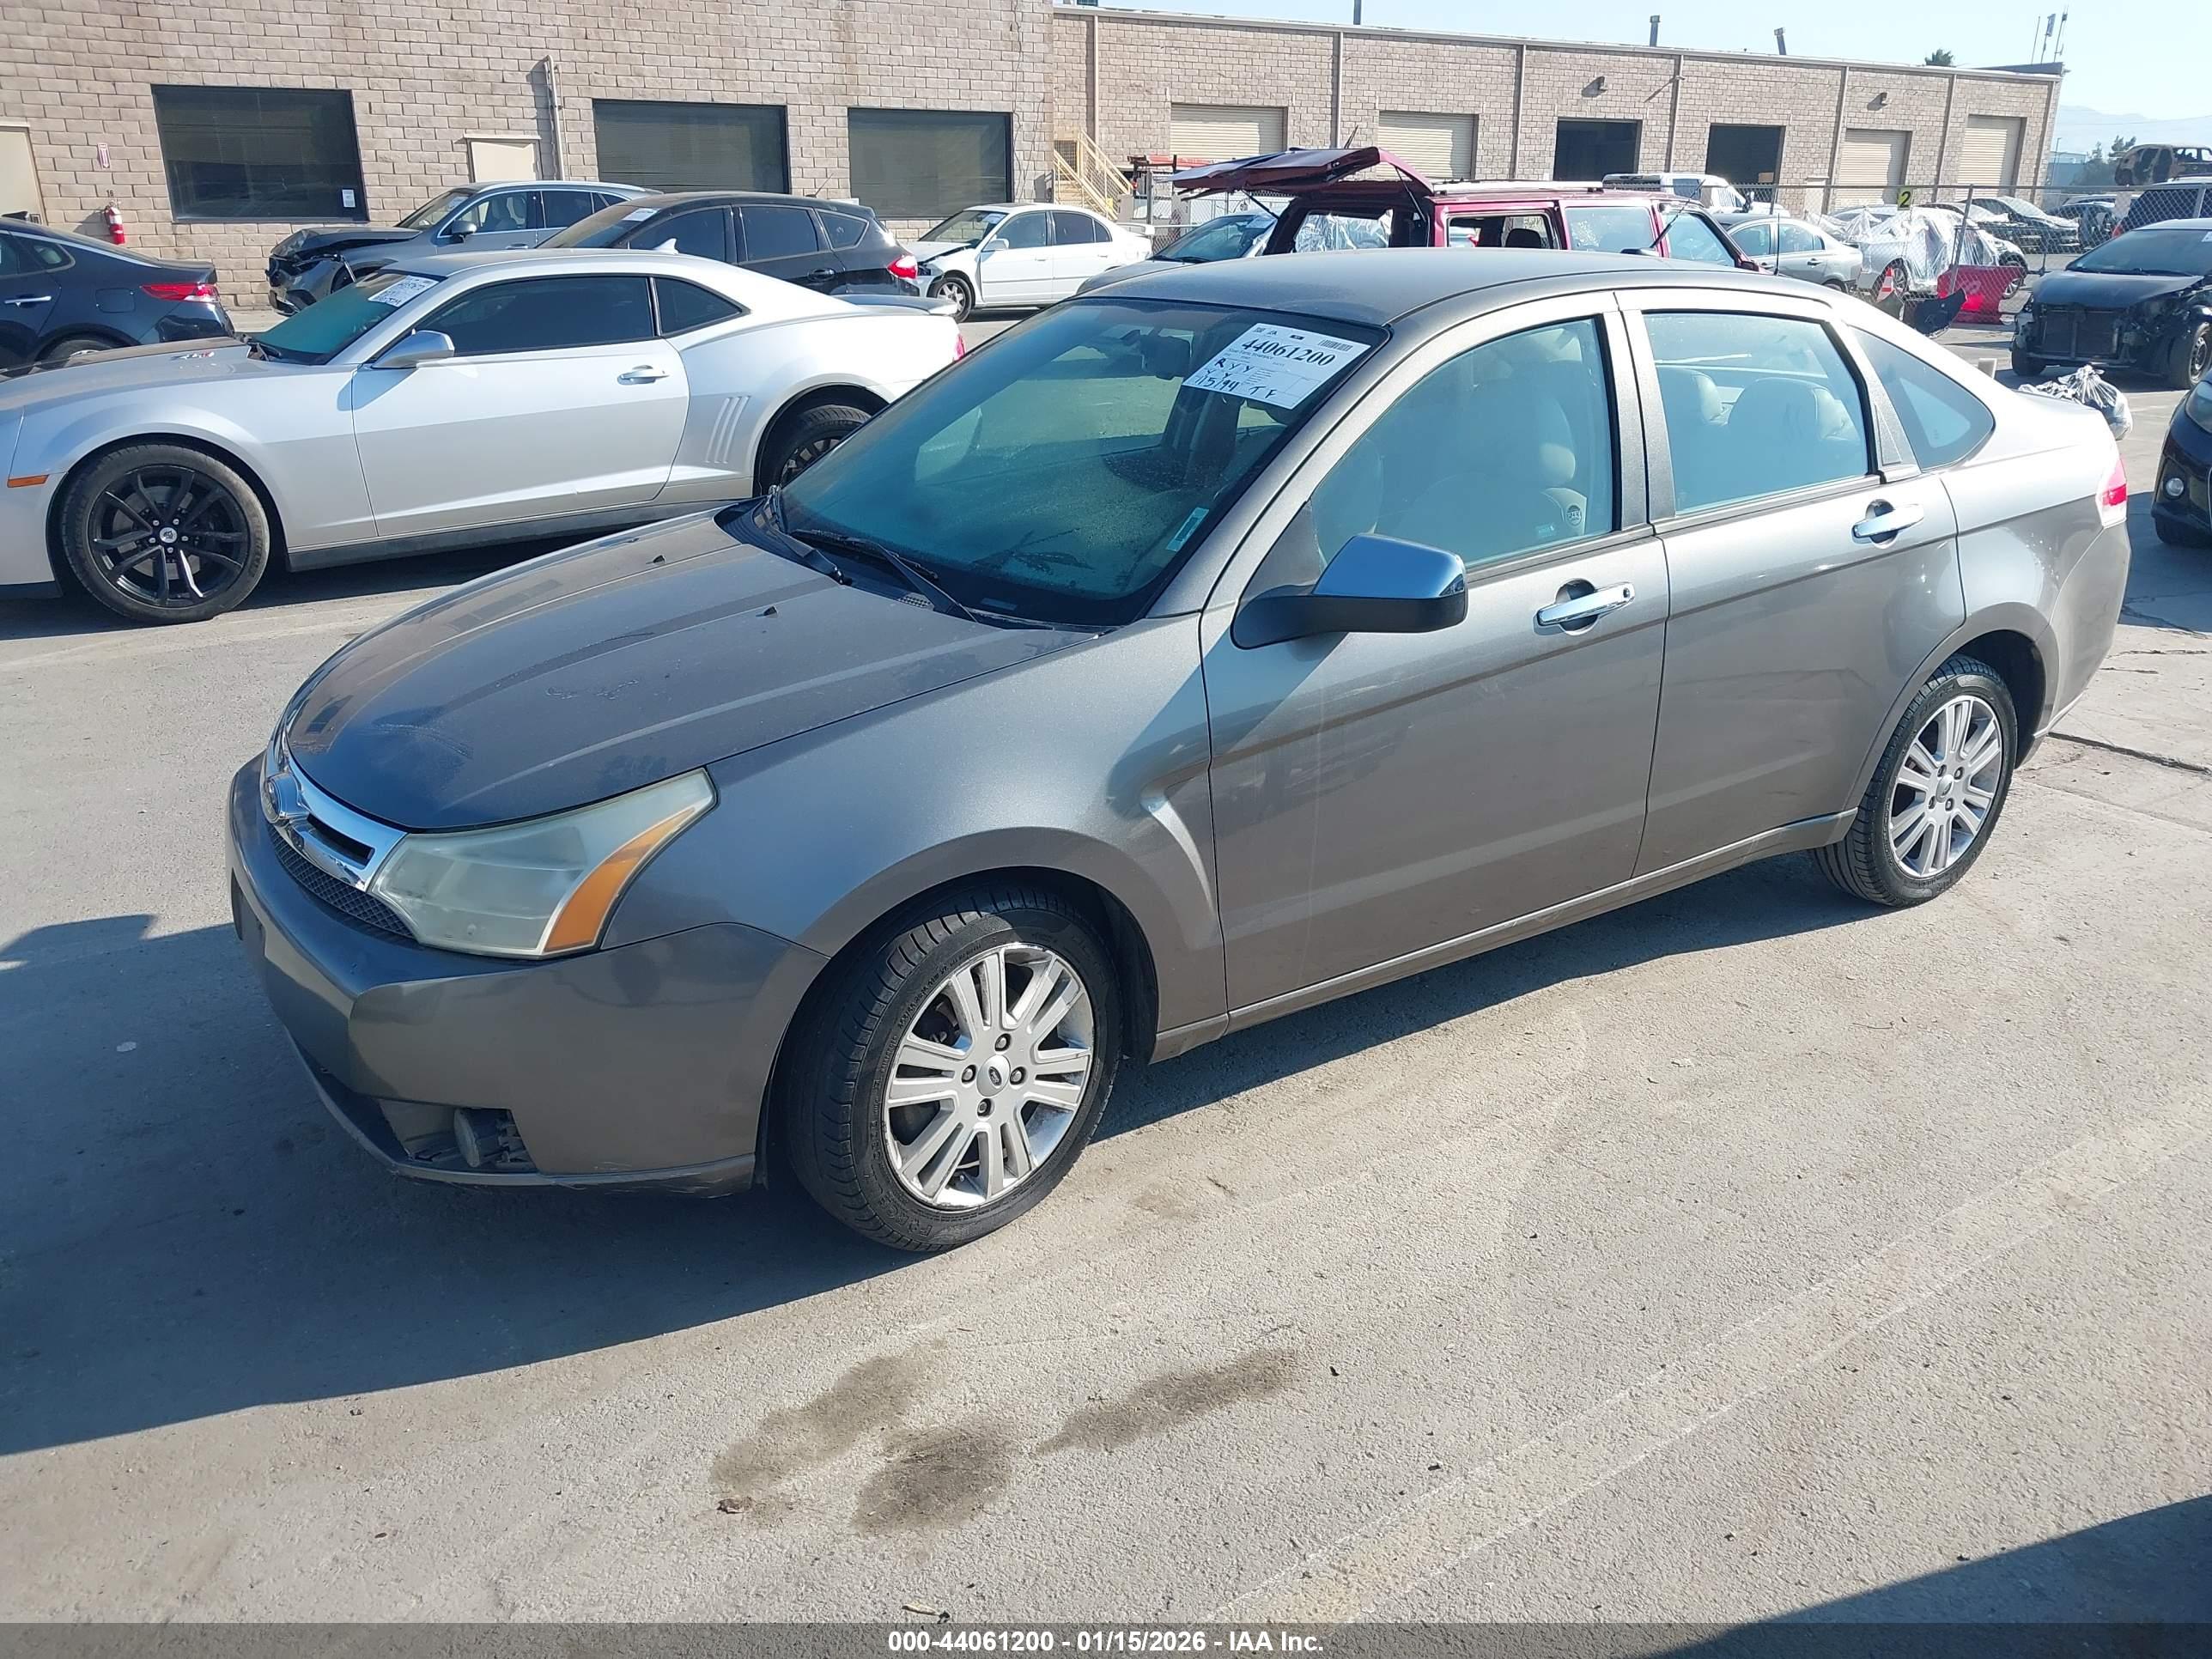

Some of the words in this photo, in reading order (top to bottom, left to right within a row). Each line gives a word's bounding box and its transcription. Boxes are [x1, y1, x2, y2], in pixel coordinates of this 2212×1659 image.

[1899, 191, 1911, 208] 2
[1242, 338, 1336, 367] 44061200
[1214, 357, 1226, 368] R
